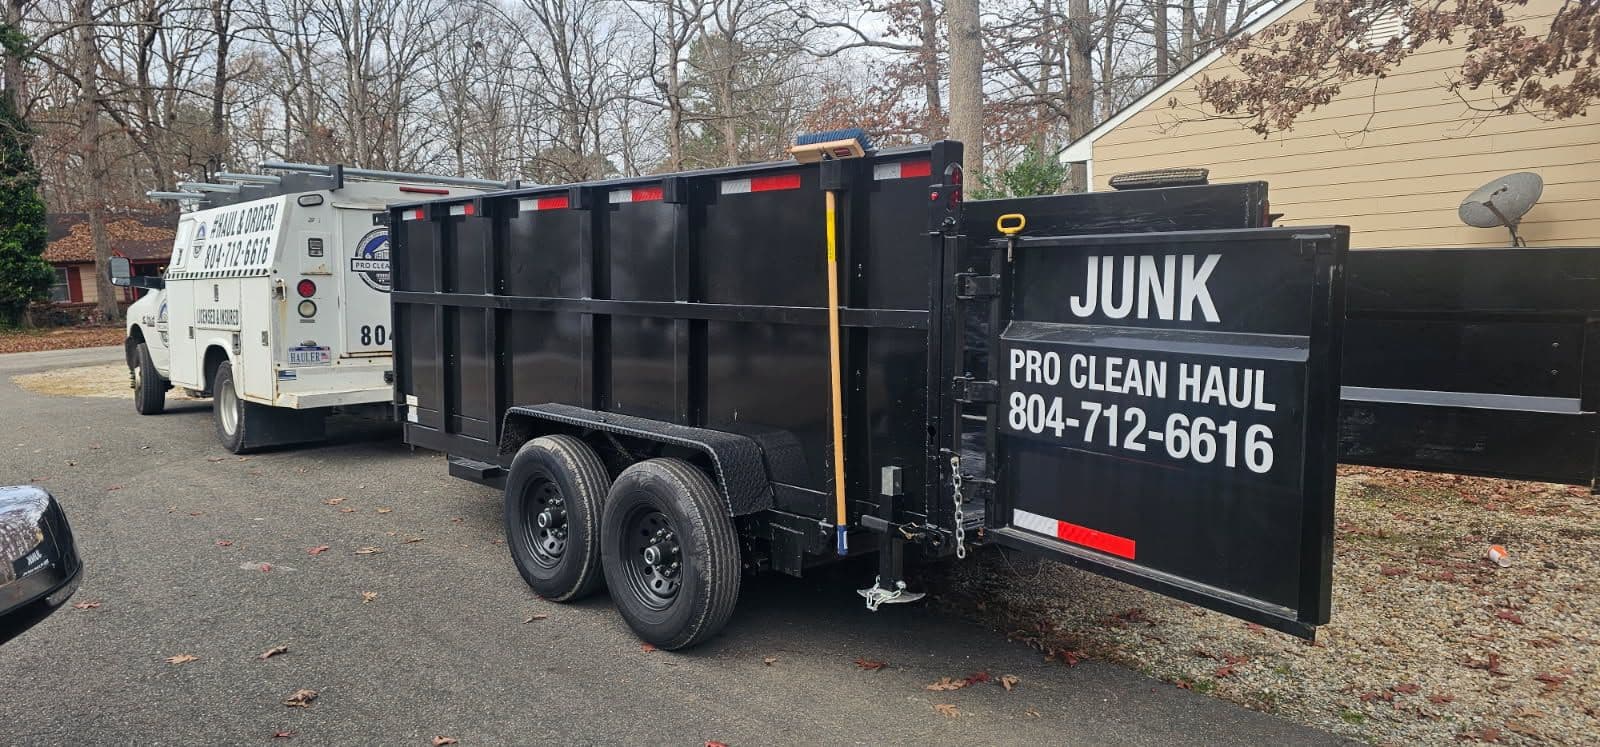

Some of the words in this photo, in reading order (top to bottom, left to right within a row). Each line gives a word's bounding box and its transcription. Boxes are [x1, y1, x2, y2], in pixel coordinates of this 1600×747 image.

[209, 210, 238, 239] #HAUL
[237, 208, 246, 235] &
[244, 202, 279, 234] ORDER!
[204, 236, 271, 269] 804-712-6616
[1069, 254, 1222, 323] JUNK
[196, 308, 216, 325] LICENSED
[220, 308, 239, 326] INSURED
[290, 351, 321, 363] HAULER
[1009, 349, 1061, 386] PRO
[1069, 353, 1167, 399] CLEAN
[1178, 363, 1276, 412] HAUL
[1008, 391, 1275, 474] 804-712-6616
